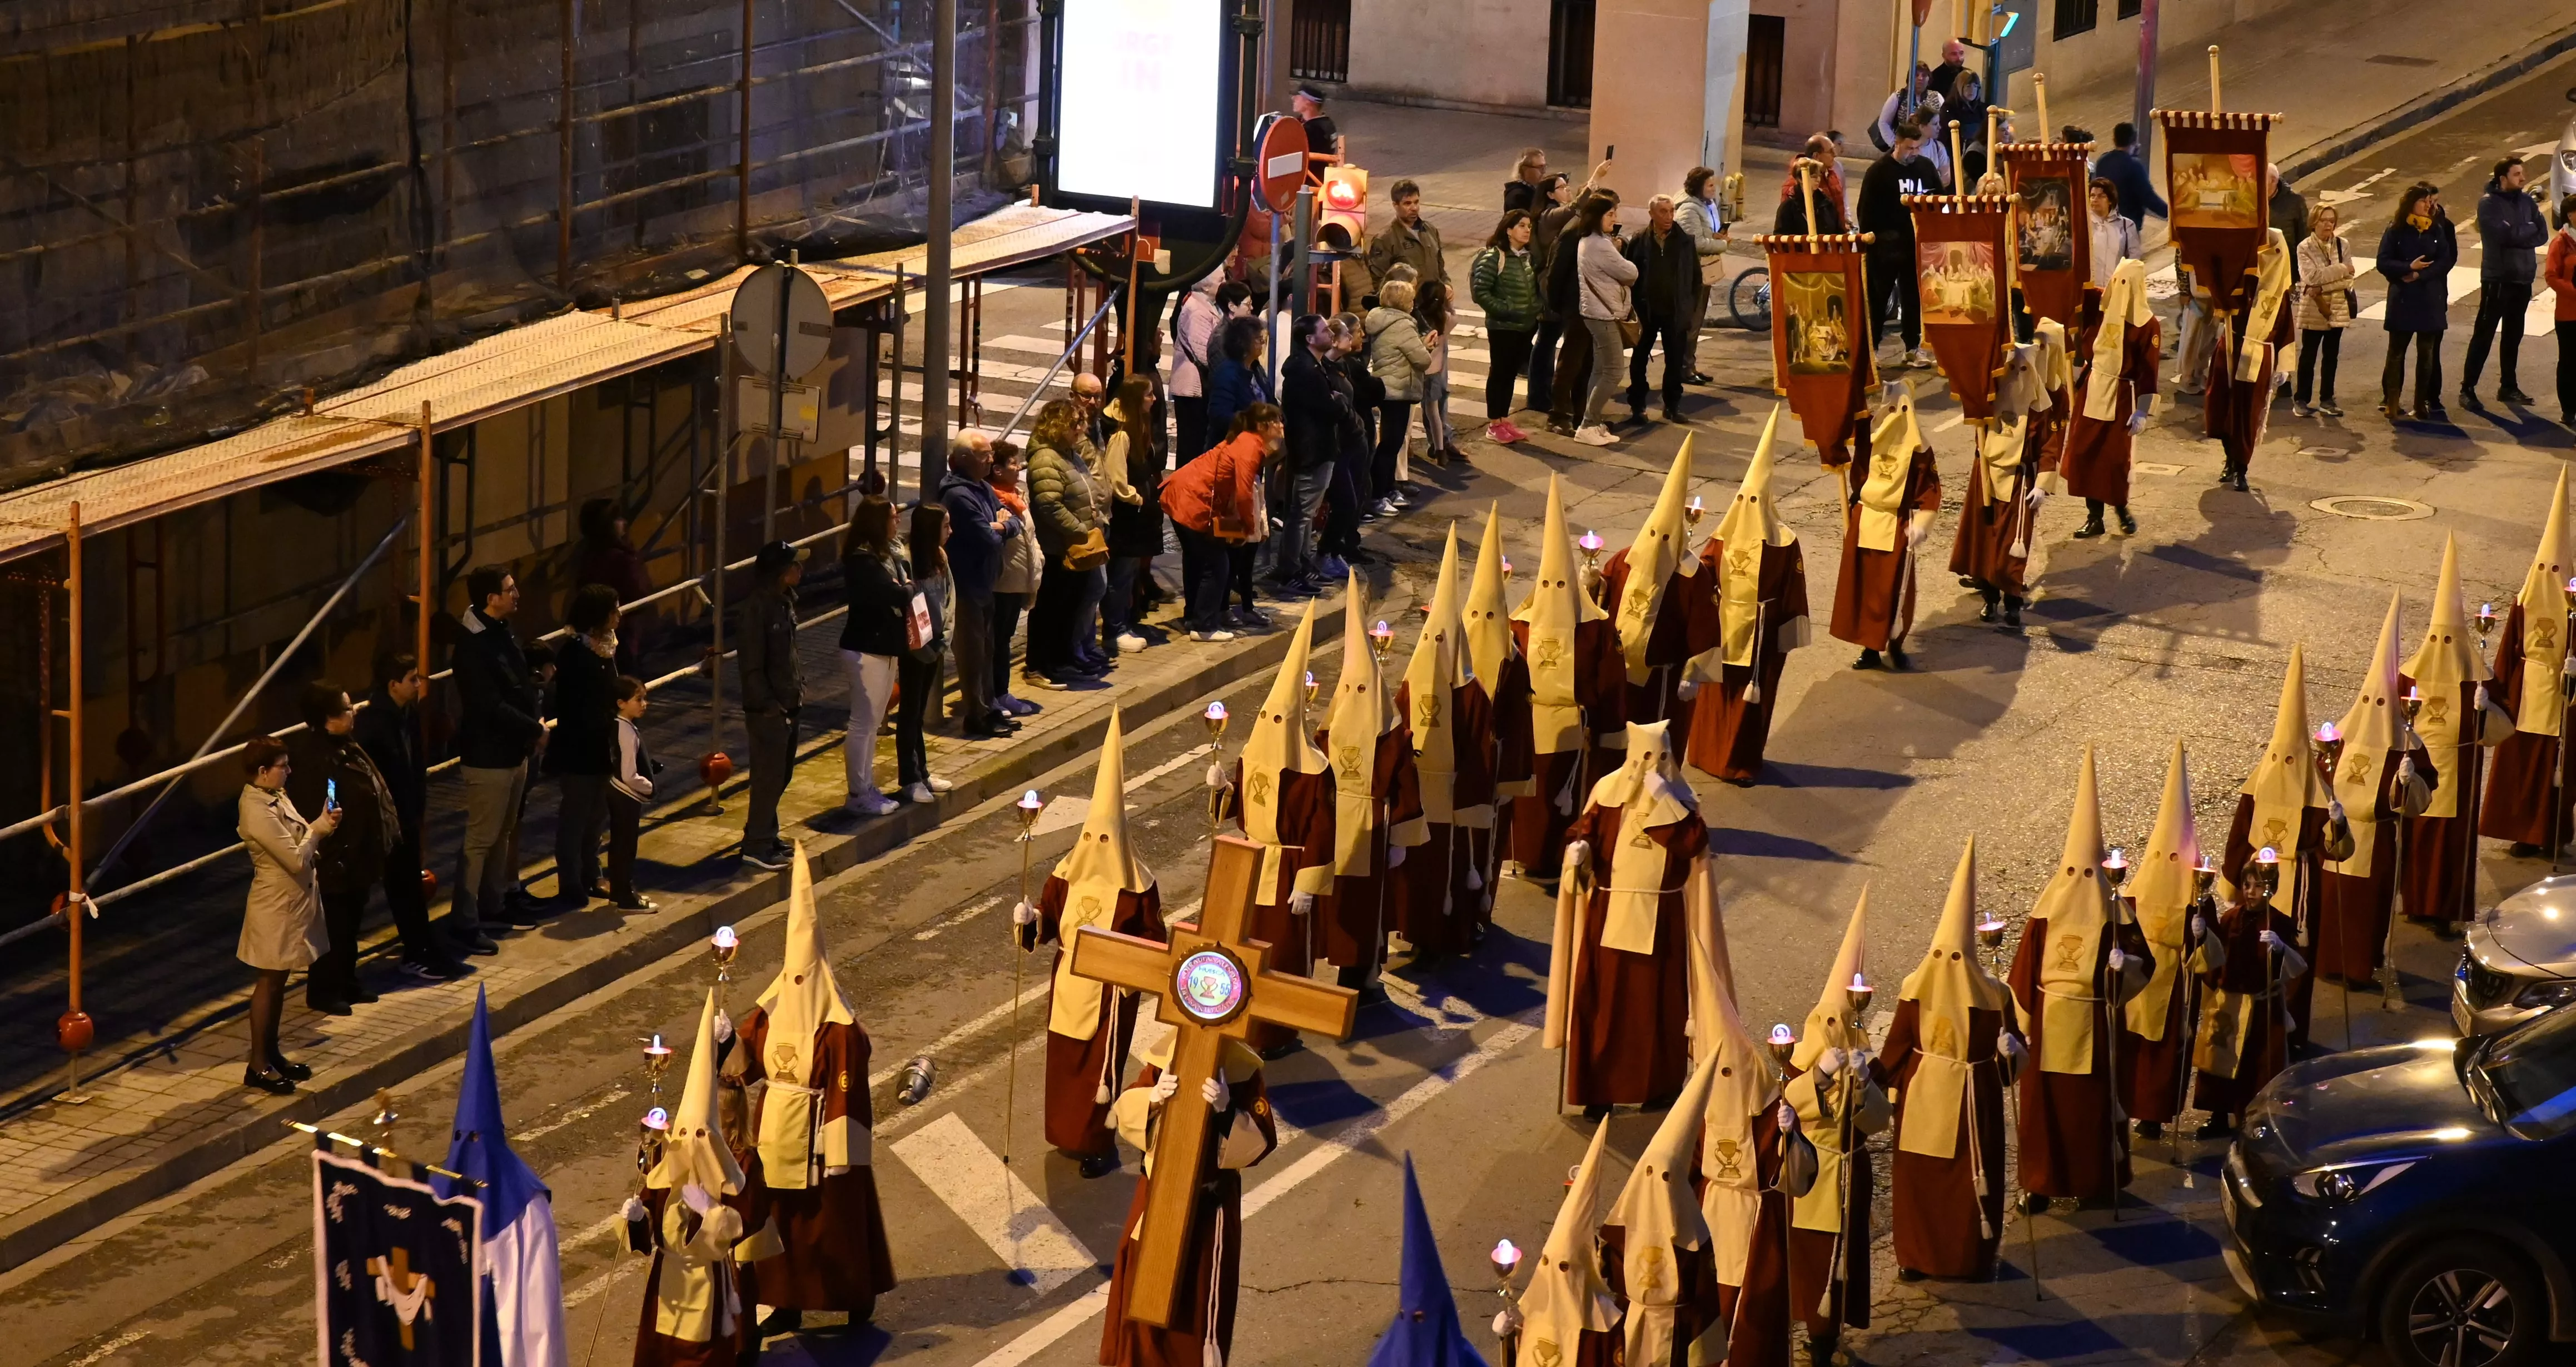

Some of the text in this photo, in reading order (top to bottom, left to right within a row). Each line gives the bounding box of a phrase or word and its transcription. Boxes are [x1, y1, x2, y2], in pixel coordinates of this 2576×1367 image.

[1199, 966, 1225, 977] HUESCA
[1190, 976, 1199, 989] 19
[1220, 983, 1231, 996] 55
